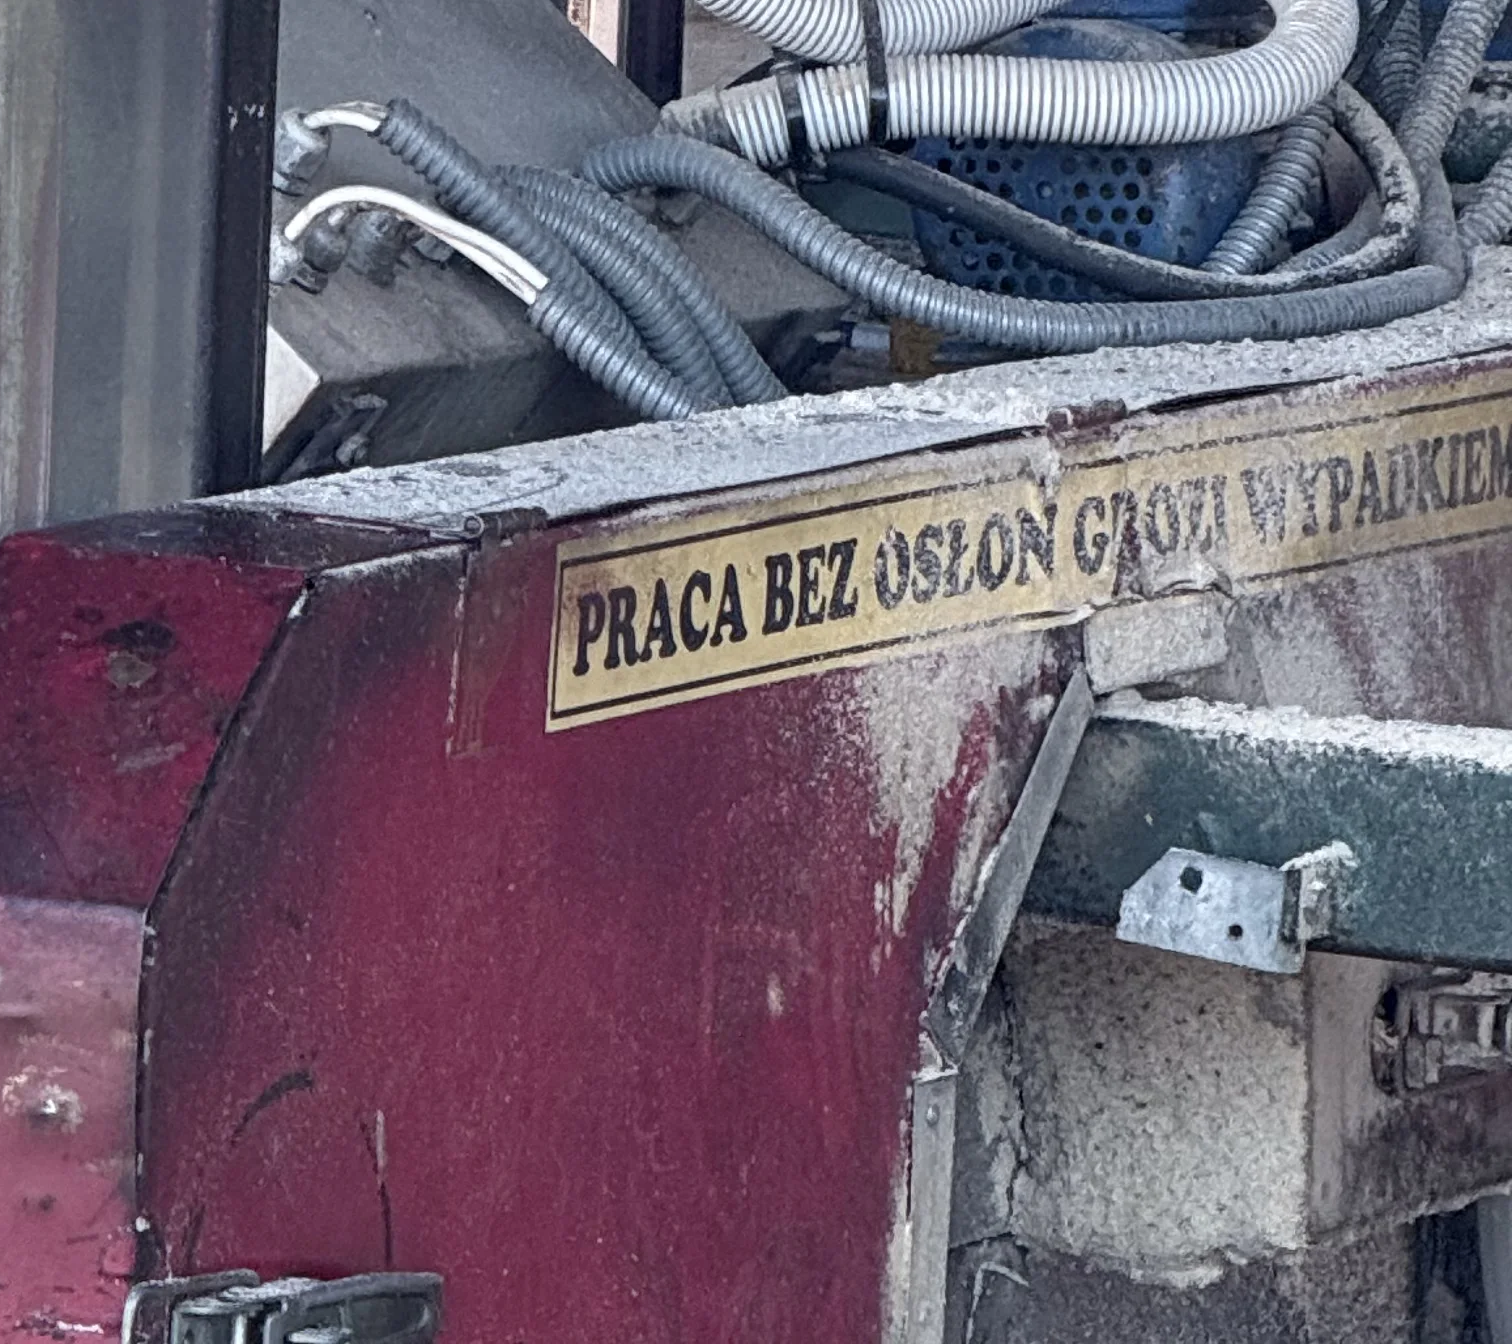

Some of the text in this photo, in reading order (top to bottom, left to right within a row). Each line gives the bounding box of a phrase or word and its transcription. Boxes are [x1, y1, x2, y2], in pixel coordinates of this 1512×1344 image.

[573, 563, 749, 676] PRACA
[762, 537, 859, 636] BEZ
[874, 503, 1058, 610] OSŁON
